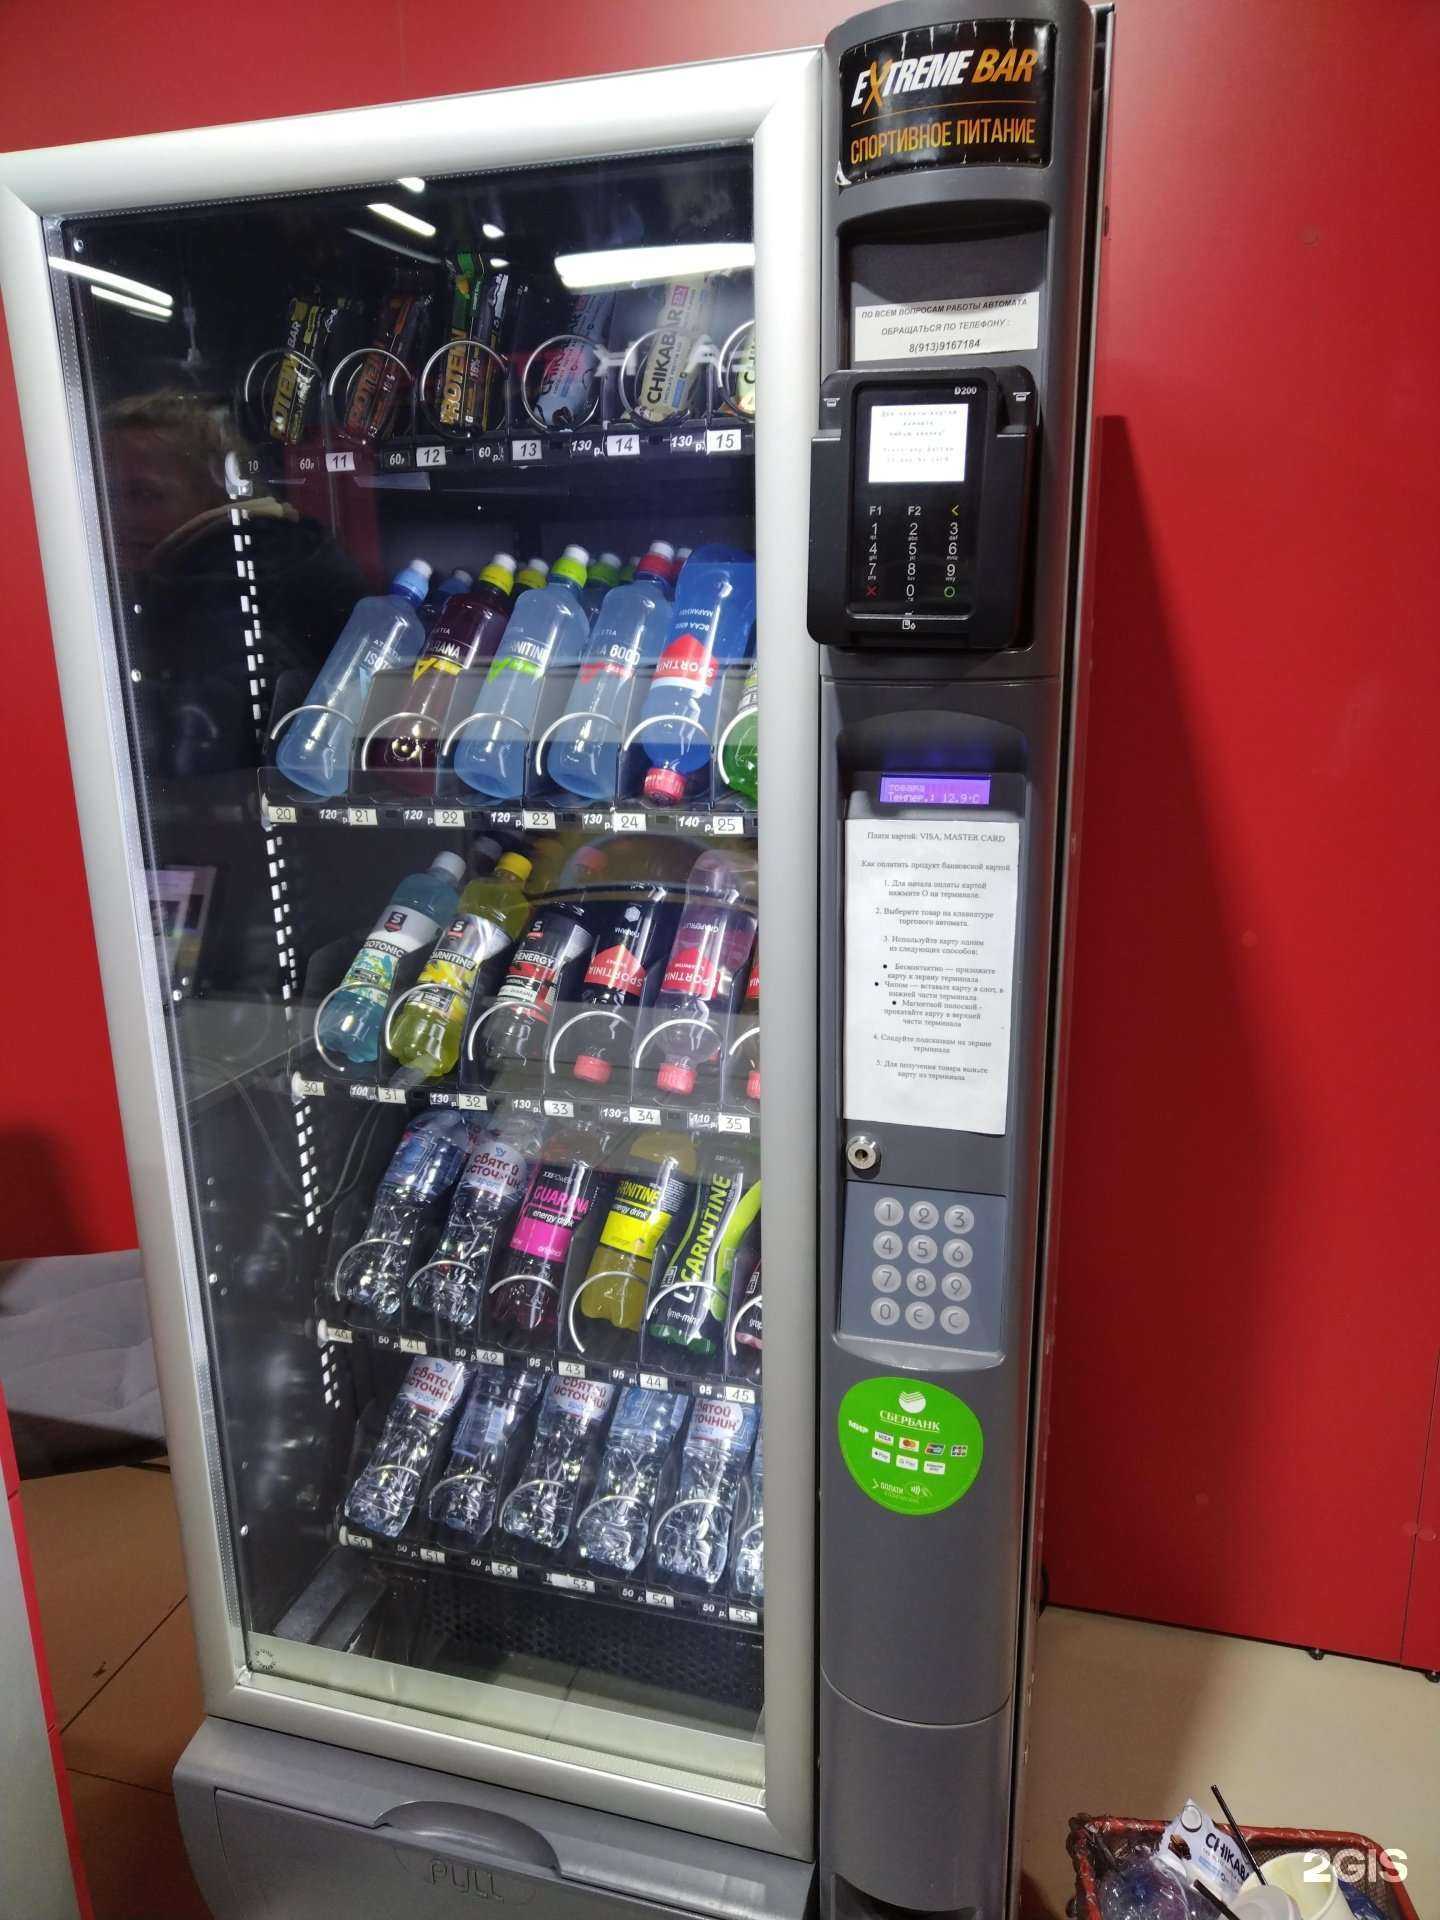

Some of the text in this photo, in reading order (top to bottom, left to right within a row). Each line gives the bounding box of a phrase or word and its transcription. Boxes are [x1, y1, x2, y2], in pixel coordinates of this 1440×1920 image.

[851, 48, 1038, 114] EXTREME BAR
[851, 119, 1036, 164] СПОРТИВНОЕ ПИТАНИЕ
[861, 299, 1027, 319] ПО ВСЕМ ВОПРОСАМ РАБОТЫ АВТОМАТА
[881, 319, 1006, 336] ОБРАЩАТЬСЯ ПО ТЕЛЕФОНУ
[909, 338, 981, 353] 8(913)9167184
[572, 439, 592, 451] 130
[615, 437, 633, 451] 14
[671, 435, 693, 447] 130
[716, 435, 735, 449] 15
[424, 449, 441, 464] 12
[479, 446, 491, 458] 60
[520, 443, 537, 457] 13
[332, 454, 348, 468] 11
[869, 505, 921, 516] F1 F2
[871, 522, 958, 535] 1 2 3
[869, 542, 957, 555] 4 5 6
[868, 562, 956, 577] 7 8 9
[906, 584, 915, 597] 0
[275, 809, 292, 821] 20
[319, 808, 338, 820] 120
[354, 810, 370, 823] 21
[404, 809, 424, 821] 120
[442, 812, 459, 824] 22
[491, 811, 511, 823] 120
[532, 813, 549, 826] 23
[583, 813, 603, 825] 130
[621, 816, 638, 829] 24
[679, 816, 700, 828] 140
[718, 818, 736, 831] 25
[303, 1082, 319, 1094] 30
[431, 1092, 449, 1104] 130
[465, 1096, 482, 1108] 32
[513, 1098, 531, 1110] 130
[550, 1103, 568, 1115] 33
[602, 1107, 621, 1119] 130
[636, 1110, 654, 1122] 34
[726, 1116, 743, 1130] 35
[885, 1204, 965, 1228] 1 2 3
[882, 1238, 964, 1262] 4 5 6
[882, 1270, 962, 1295] 7 8 9
[949, 1312, 960, 1328] C
[646, 1376, 662, 1388] 44
[732, 1390, 750, 1401] 45
[880, 1410, 941, 1431] СБЕРБАНК
[430, 1859, 505, 1904] PULL
